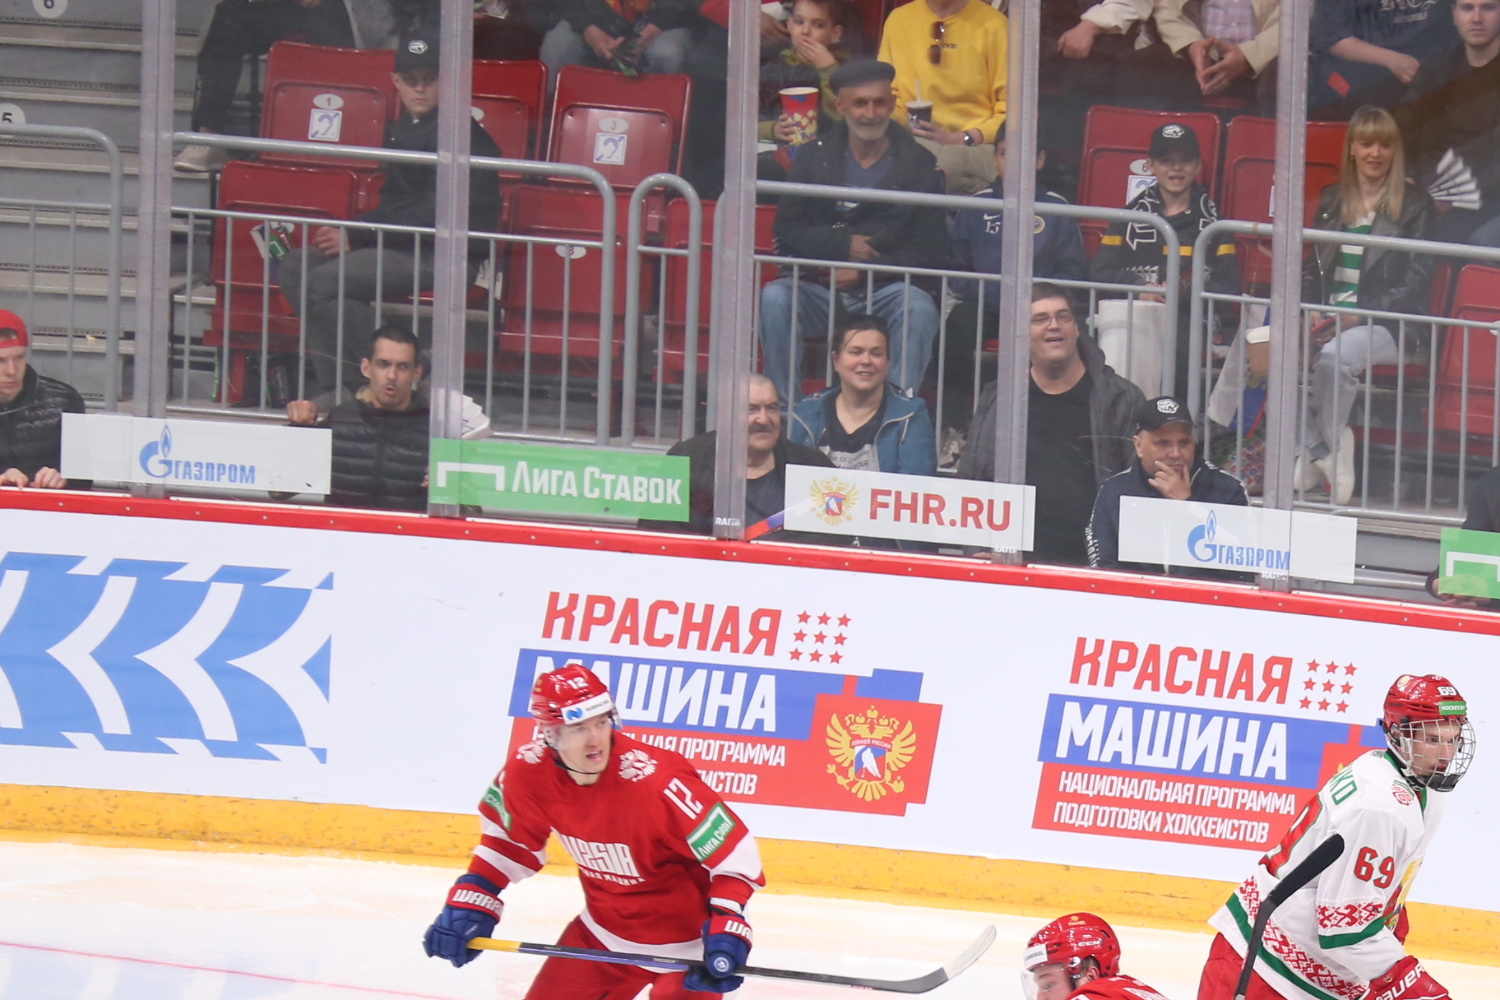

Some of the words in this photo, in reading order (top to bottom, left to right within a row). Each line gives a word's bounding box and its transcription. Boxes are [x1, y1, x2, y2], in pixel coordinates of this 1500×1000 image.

[174, 459, 256, 485] ГАЗПРОМ
[869, 488, 1012, 532] FHR.RU
[1217, 543, 1291, 571] ГАЗПРОМ
[541, 591, 783, 657] КРАСНАЯ
[1069, 636, 1294, 705] КРАСНАЯ
[1436, 686, 1457, 697] 69
[679, 736, 786, 767] ПРОГРАММА
[1055, 700, 1288, 782] МАШИНА
[663, 776, 705, 821] 12
[1058, 770, 1193, 806] НАЦИОНАЛЬНАЯ
[1194, 784, 1297, 817] ПРОГРАММА
[1052, 801, 1162, 831] ПОДГОТОВКИ
[1162, 810, 1270, 844] ХОККЕИСТОВ
[1353, 845, 1395, 890] 69
